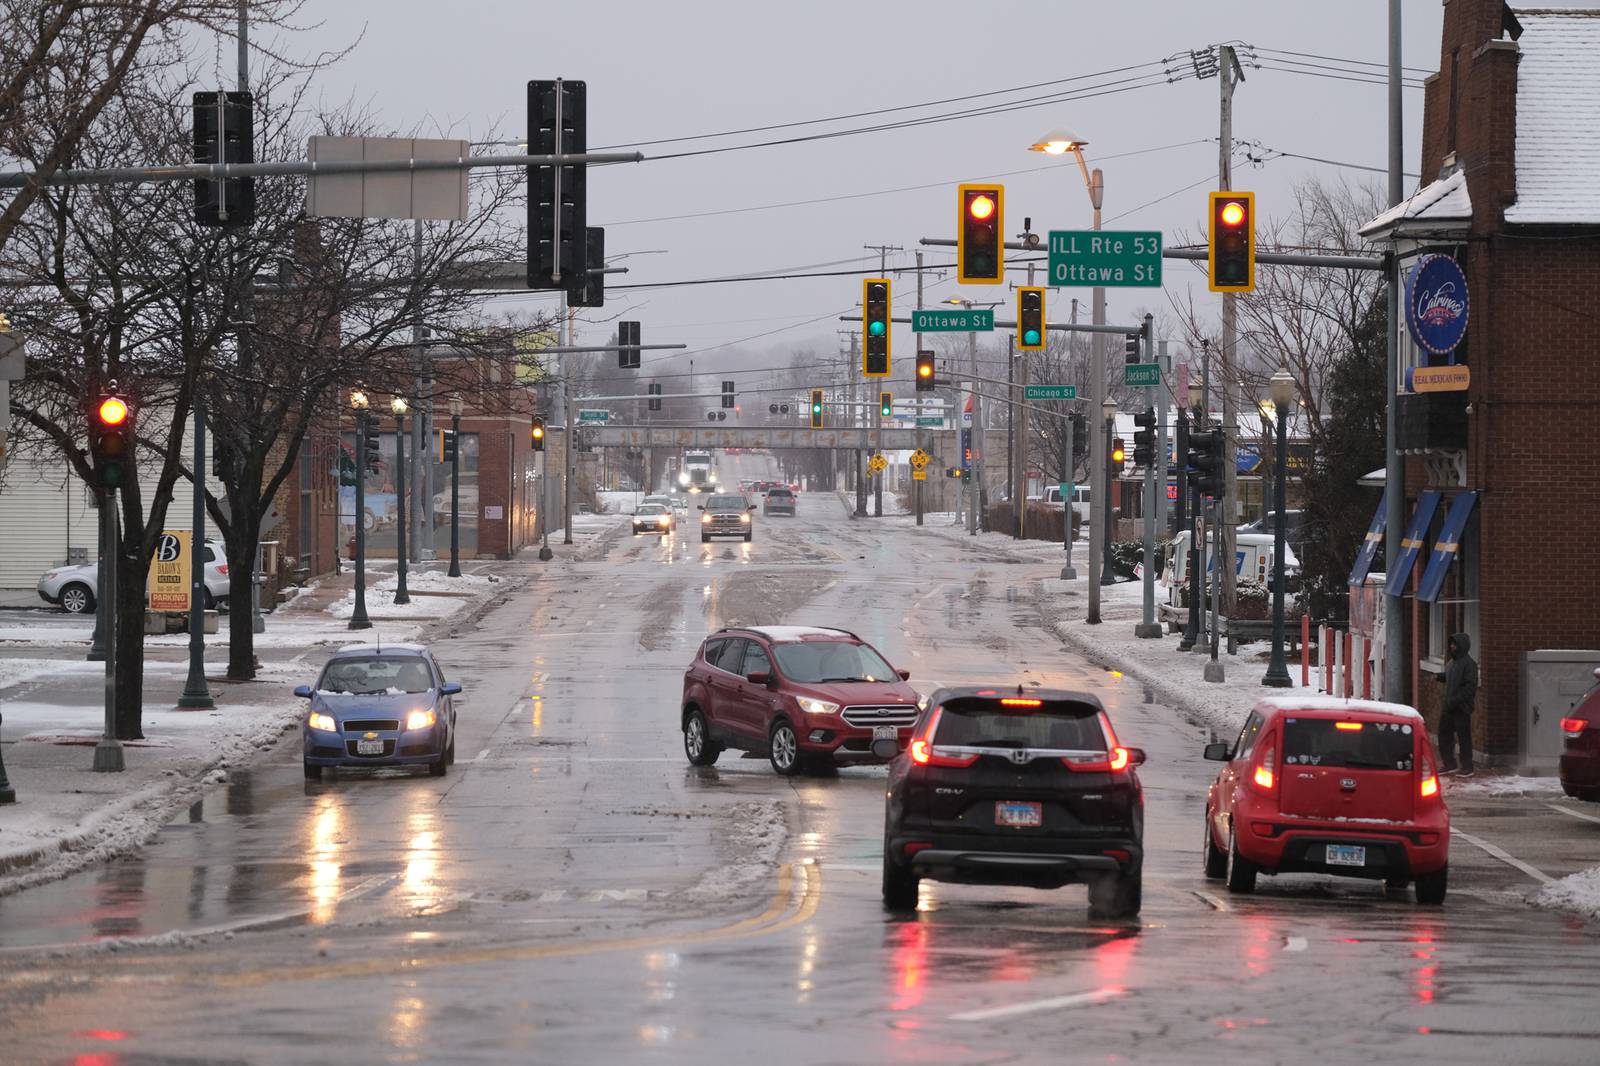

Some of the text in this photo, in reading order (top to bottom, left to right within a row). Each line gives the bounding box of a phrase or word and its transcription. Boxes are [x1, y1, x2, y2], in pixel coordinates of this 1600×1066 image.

[1052, 237, 1158, 255] ILL Rte 53
[1056, 263, 1155, 281] Ottawa St
[919, 315, 987, 327] Ottawa St
[1126, 368, 1159, 382] Jackson St
[1414, 375, 1429, 385] REAL
[1430, 374, 1453, 385] MEXICAN
[1027, 388, 1073, 398] Chicago St
[157, 562, 181, 575] BARON'S
[153, 594, 186, 602] PARKING
